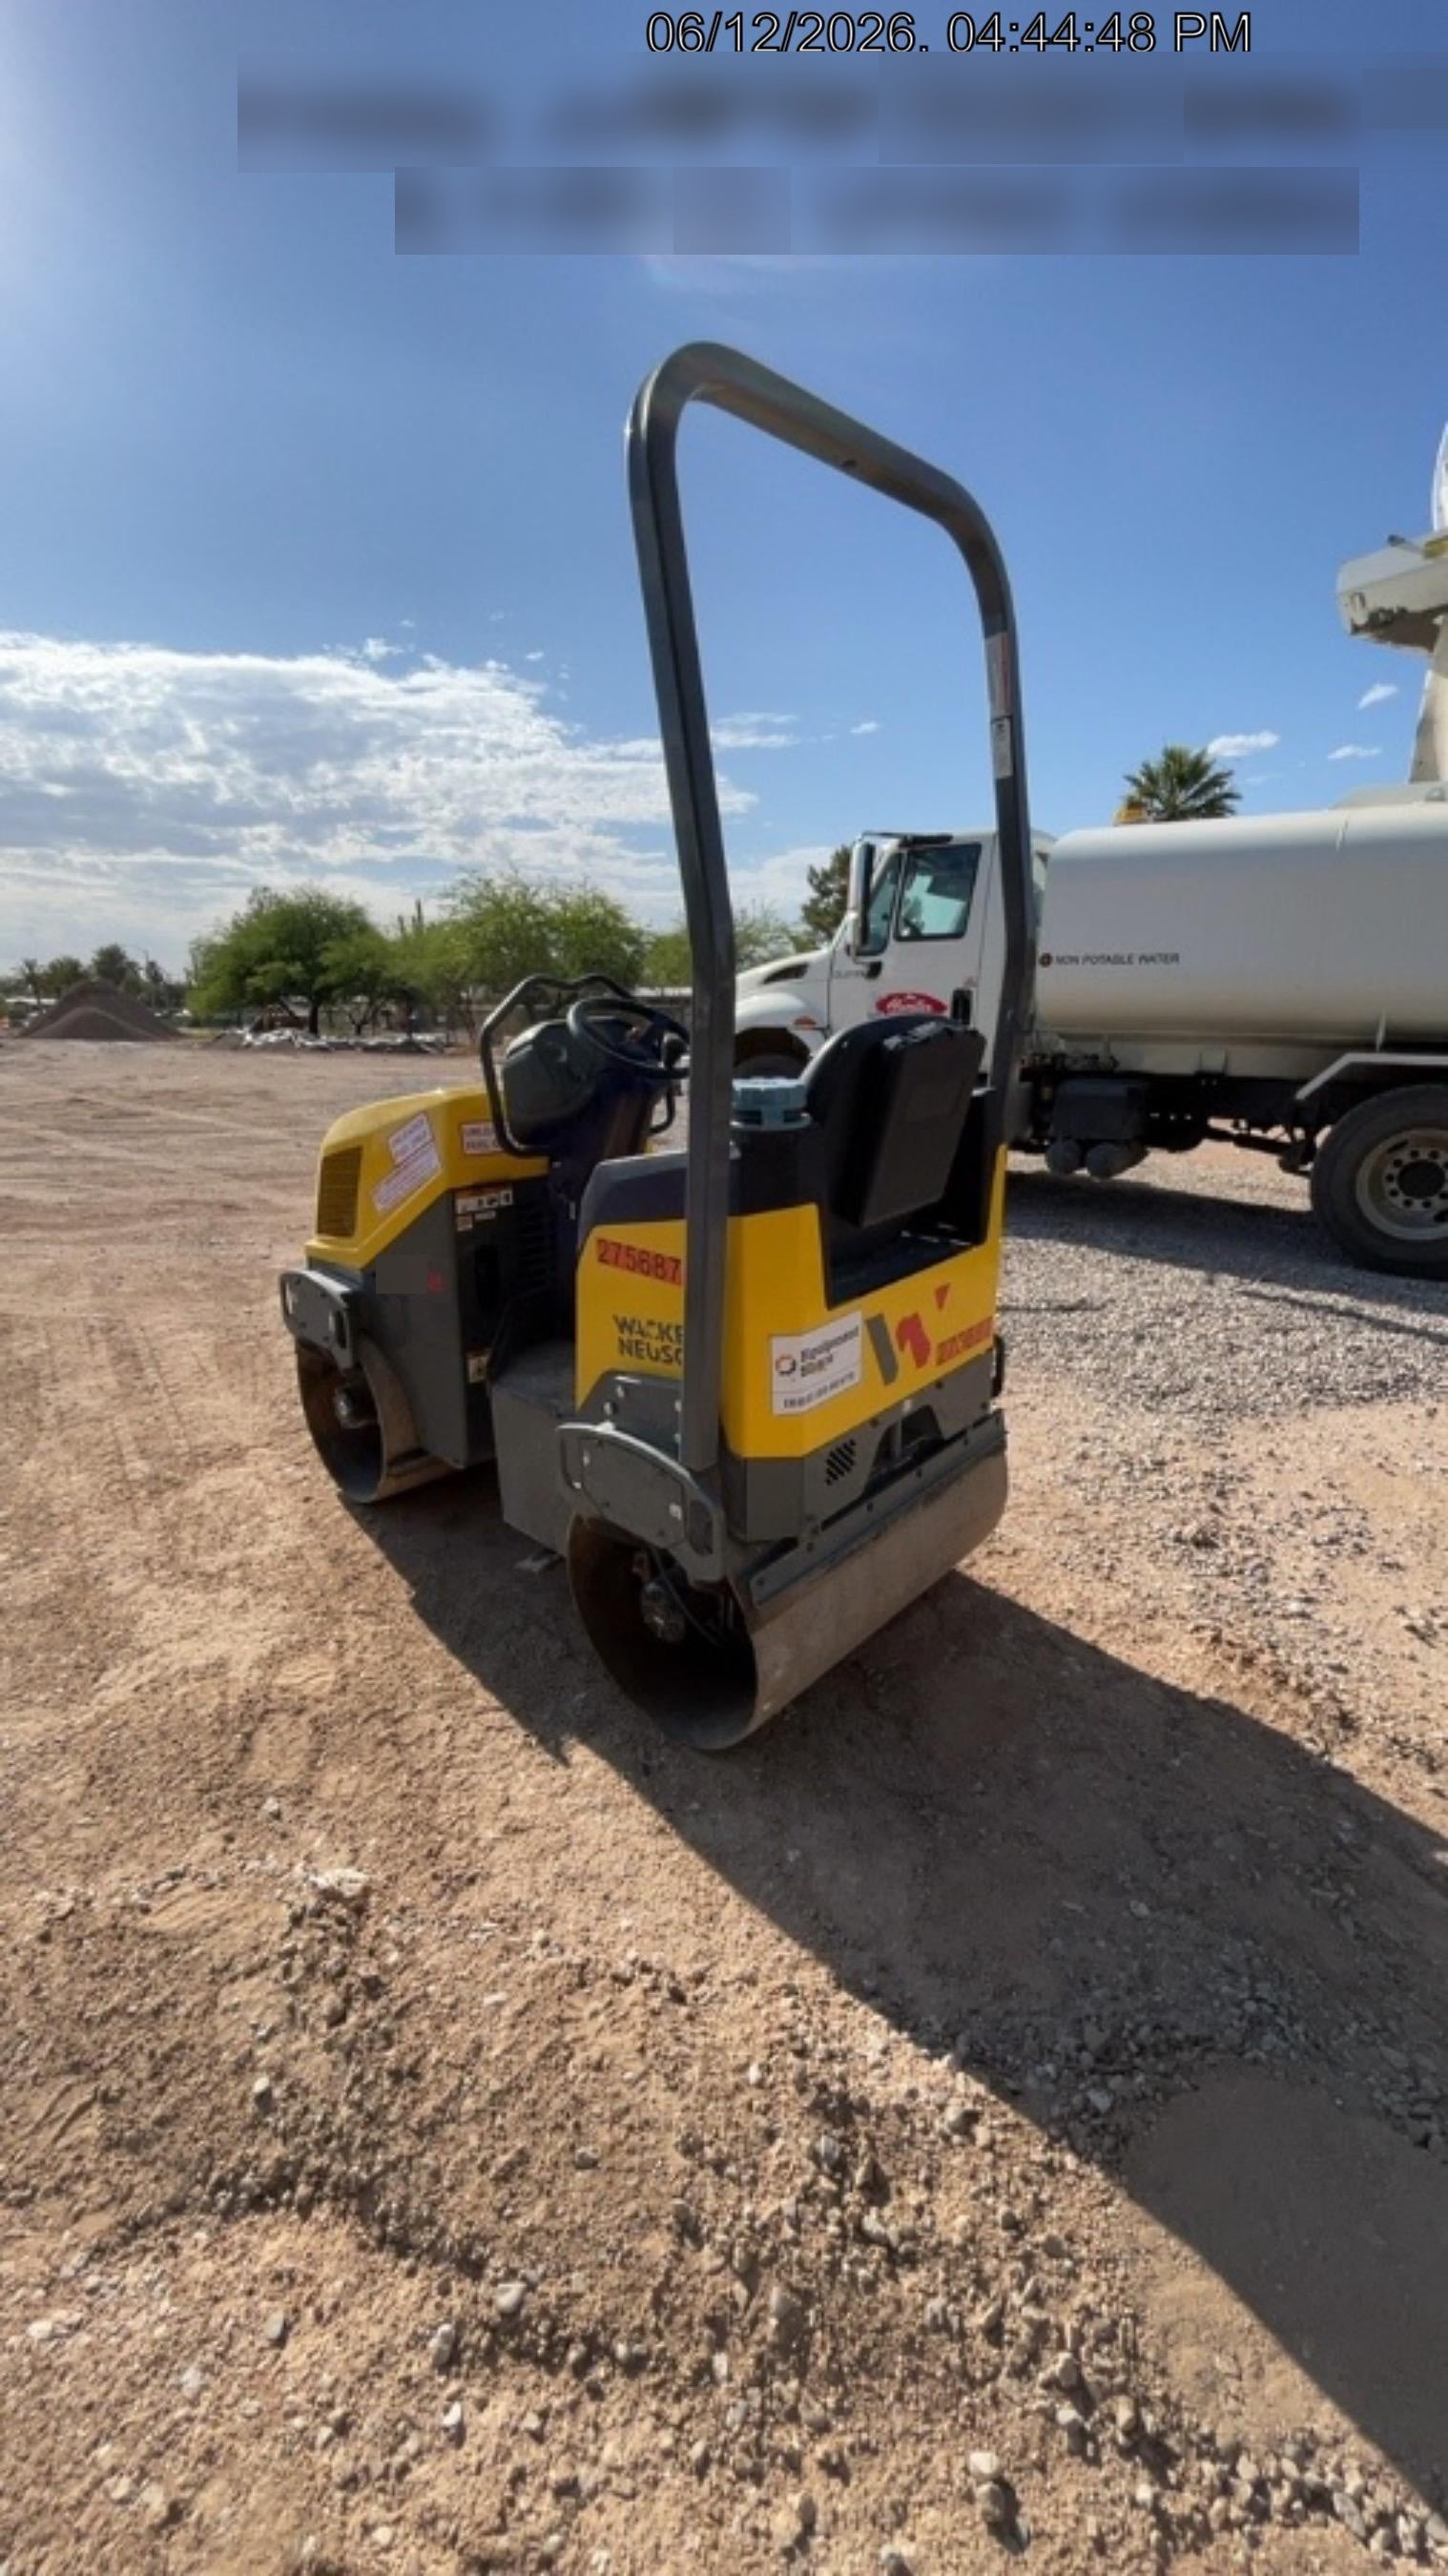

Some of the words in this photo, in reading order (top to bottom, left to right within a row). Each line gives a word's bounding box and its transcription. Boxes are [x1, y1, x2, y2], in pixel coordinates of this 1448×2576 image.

[1082, 954, 1134, 966] POTABLE
[1139, 953, 1180, 965] WATER
[596, 1237, 682, 1286] 275687
[612, 1313, 683, 1344] WACKE
[617, 1336, 683, 1366] NEUS
